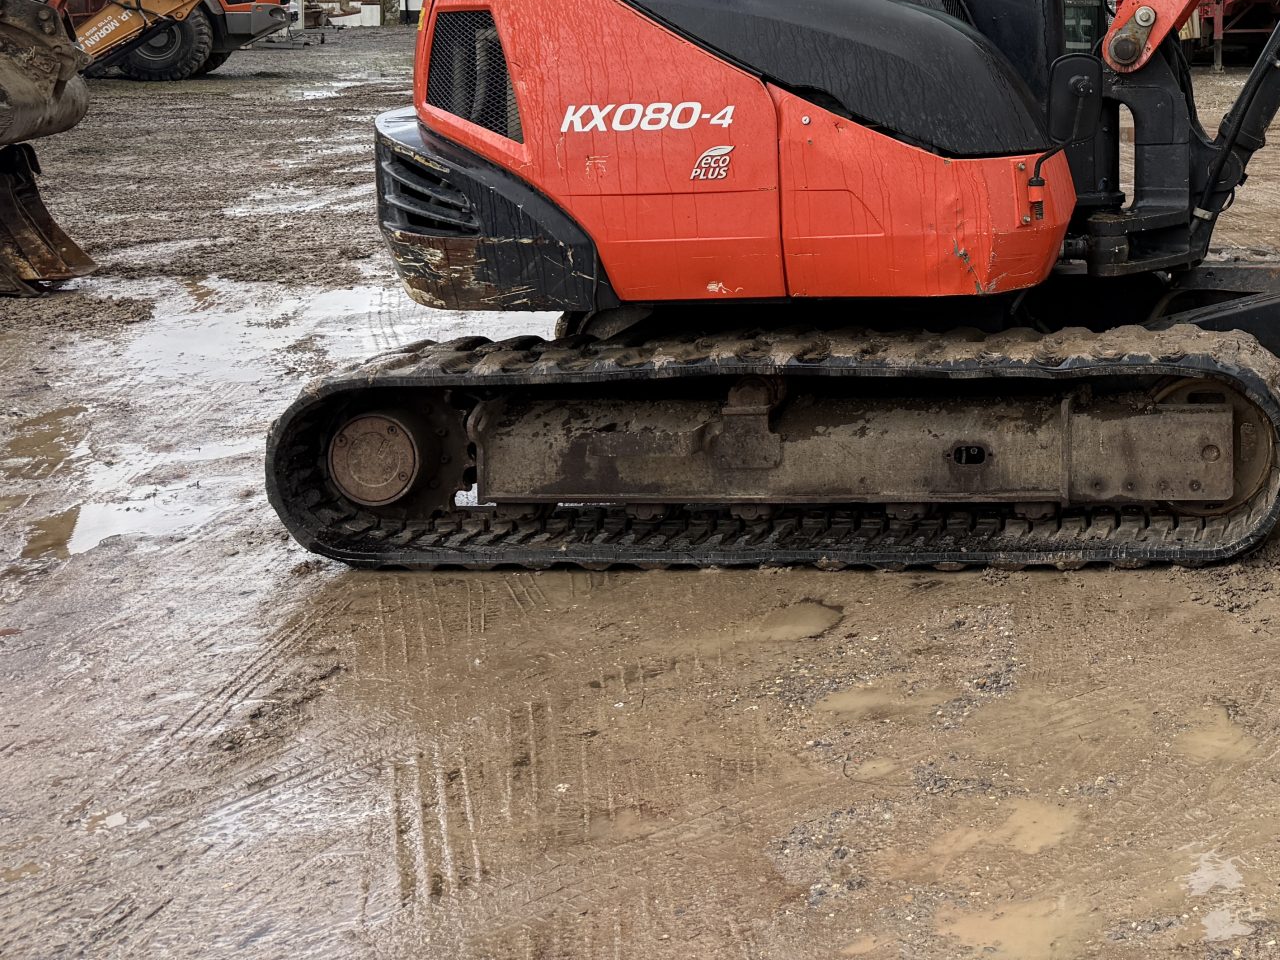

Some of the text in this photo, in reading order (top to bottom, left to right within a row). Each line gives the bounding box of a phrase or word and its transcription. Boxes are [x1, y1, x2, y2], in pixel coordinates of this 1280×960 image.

[84, 20, 120, 48] MORAN
[560, 101, 735, 133] KX080-4
[689, 166, 728, 180] PLUS
